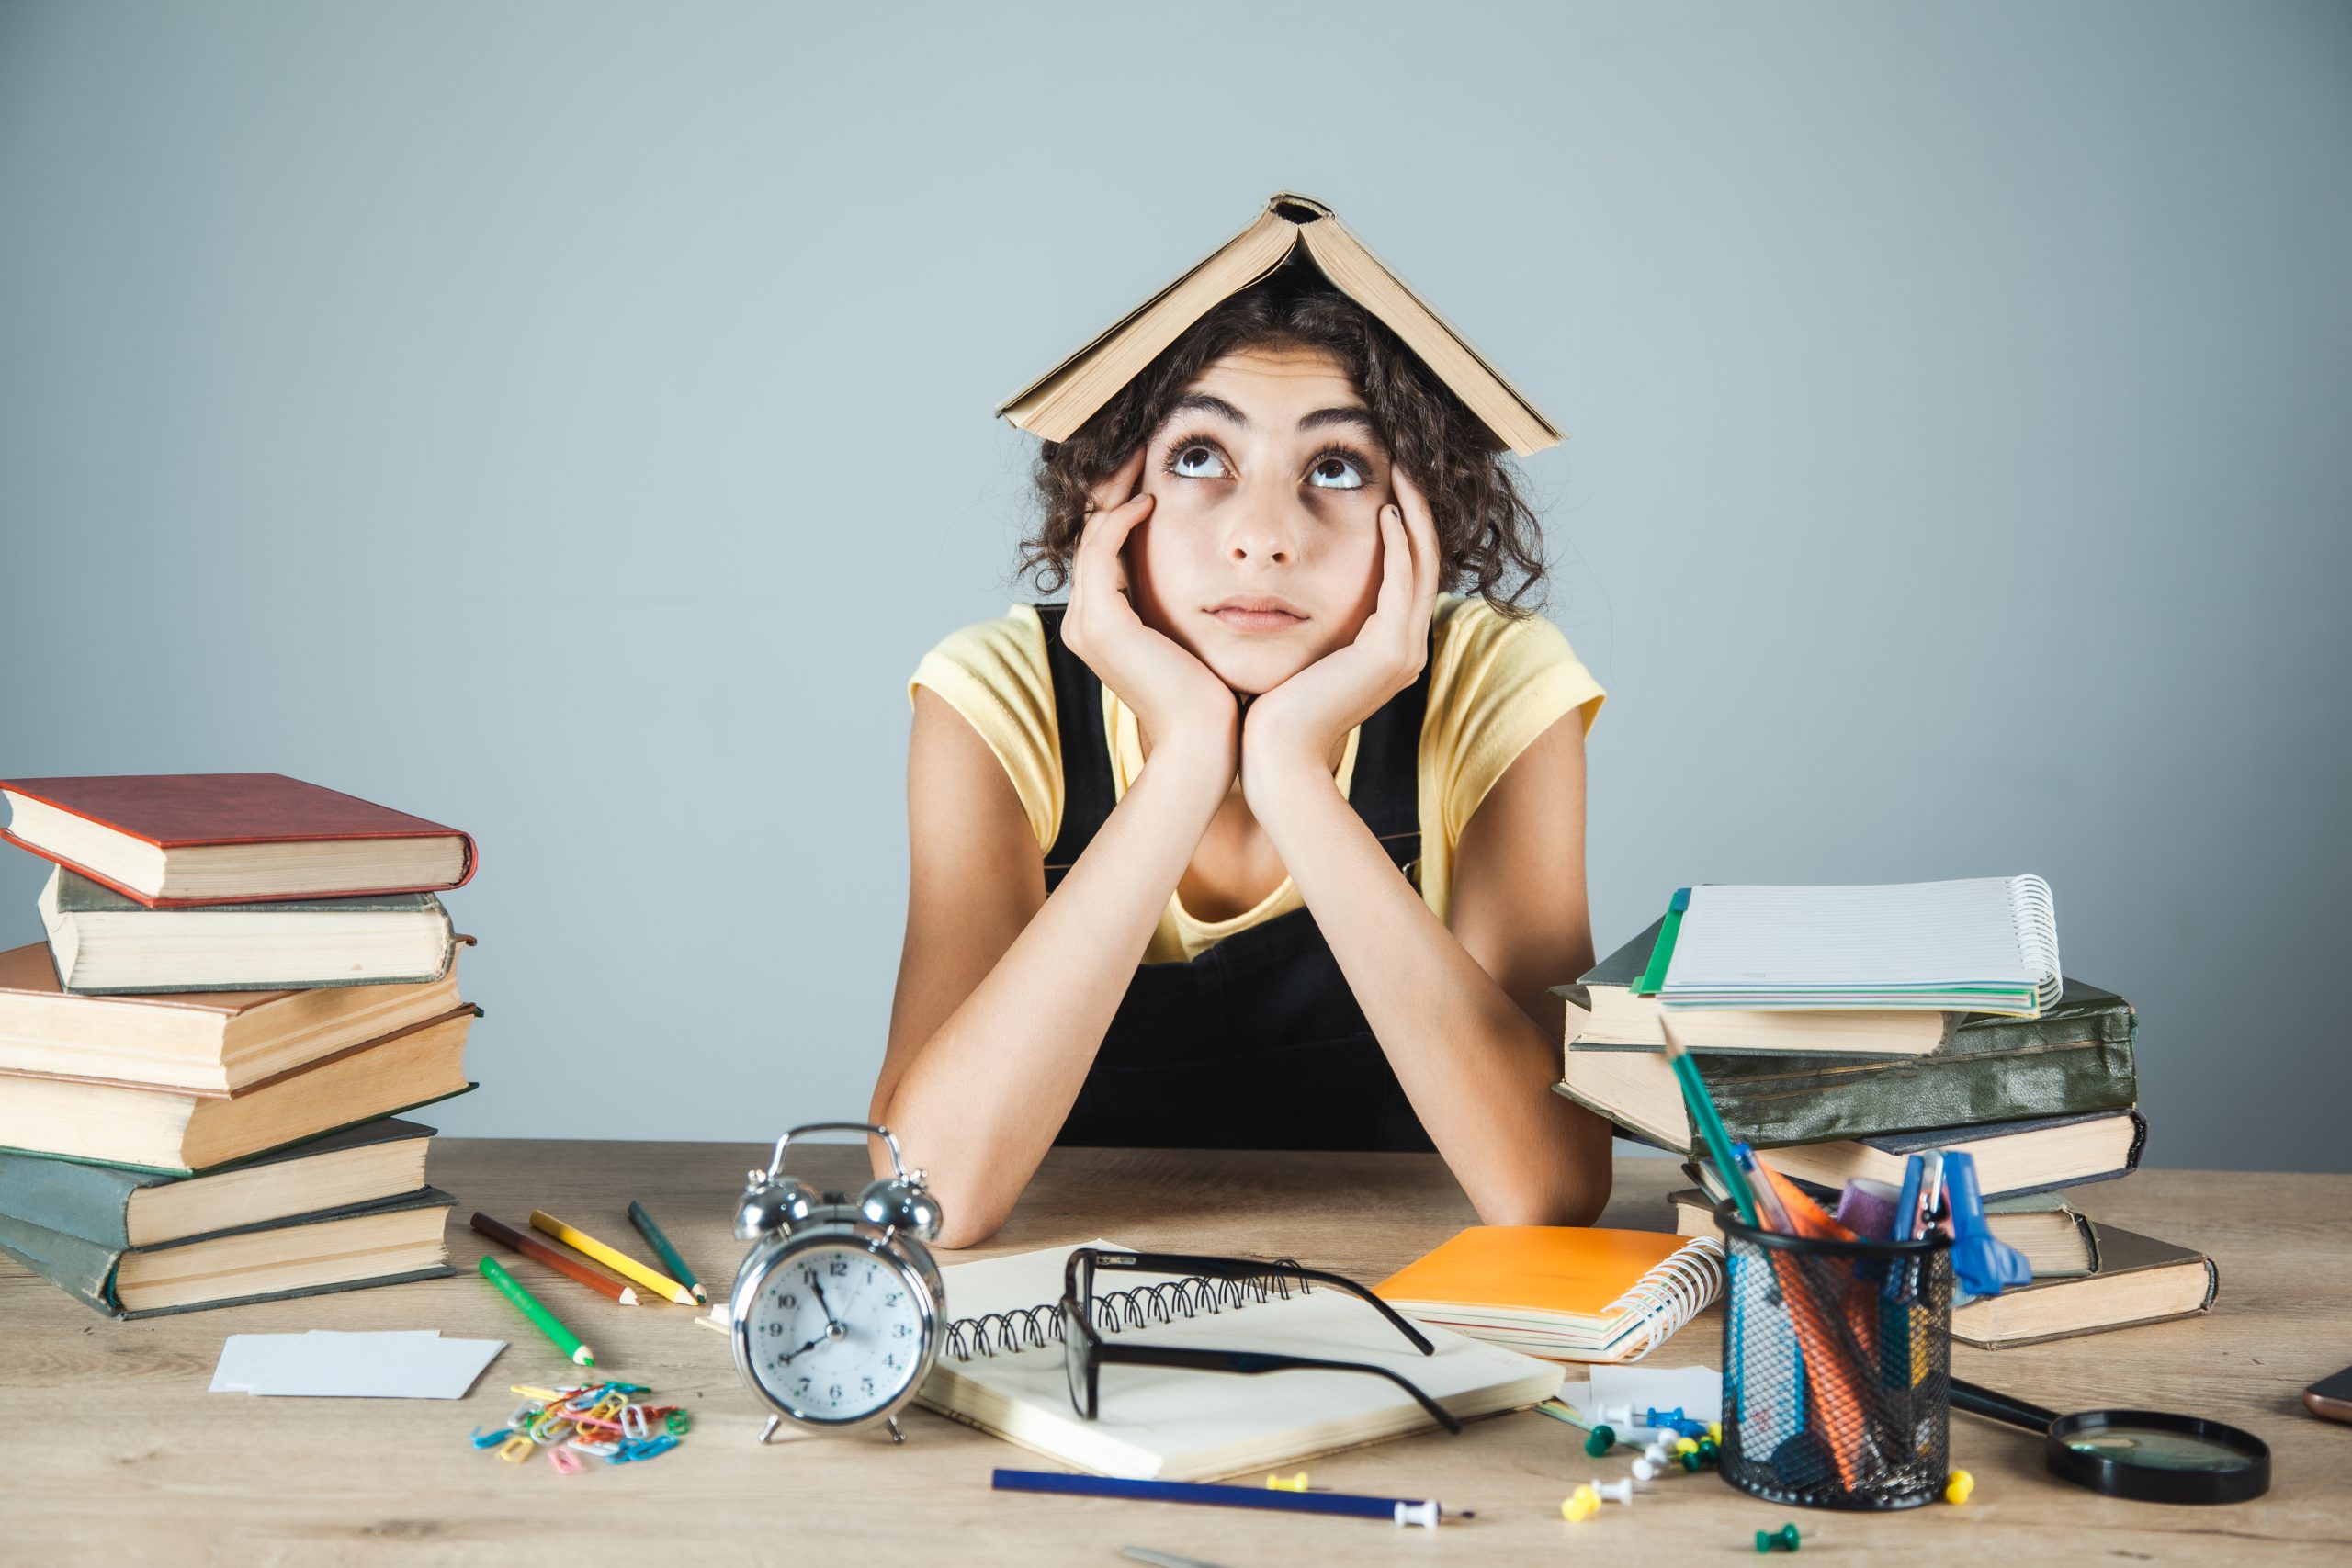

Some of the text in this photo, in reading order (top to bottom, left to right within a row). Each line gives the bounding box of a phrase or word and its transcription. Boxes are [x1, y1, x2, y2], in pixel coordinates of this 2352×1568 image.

[829, 1263, 847, 1277] 12
[866, 1272, 872, 1284] 1
[778, 1295, 797, 1310] 10
[885, 1293, 897, 1306] 2
[769, 1323, 783, 1337] 9
[893, 1325, 905, 1338] 3
[777, 1354, 791, 1368] 8
[882, 1354, 894, 1367] 4
[798, 1378, 811, 1392] 7
[830, 1385, 842, 1399] 6
[861, 1378, 874, 1392] 5
